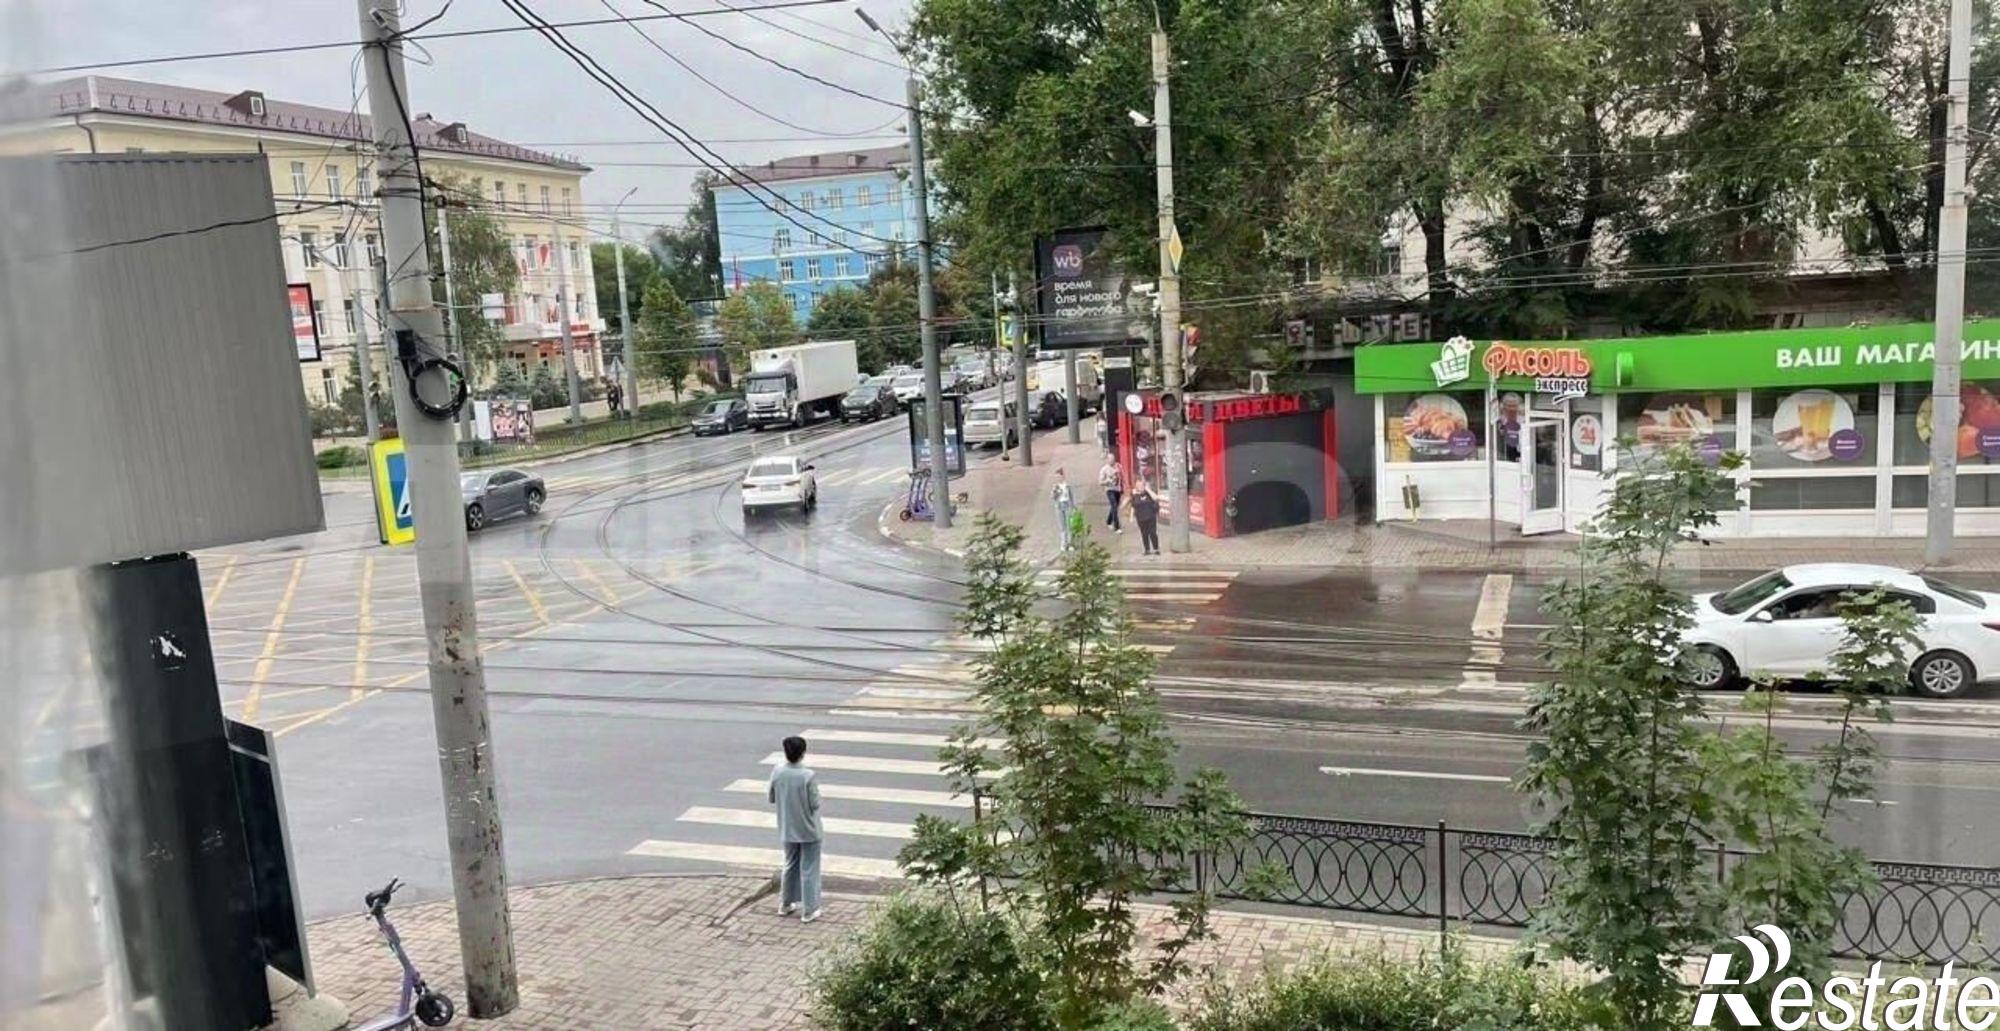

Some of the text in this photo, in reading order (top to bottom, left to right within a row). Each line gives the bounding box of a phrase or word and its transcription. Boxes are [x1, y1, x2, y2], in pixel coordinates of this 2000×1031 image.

[1053, 251, 1080, 268] wb
[1054, 280, 1093, 292] время
[1054, 291, 1122, 304] для нового
[1776, 340, 2000, 369] ВАШ МАГАИН
[1580, 426, 1596, 446] 24
